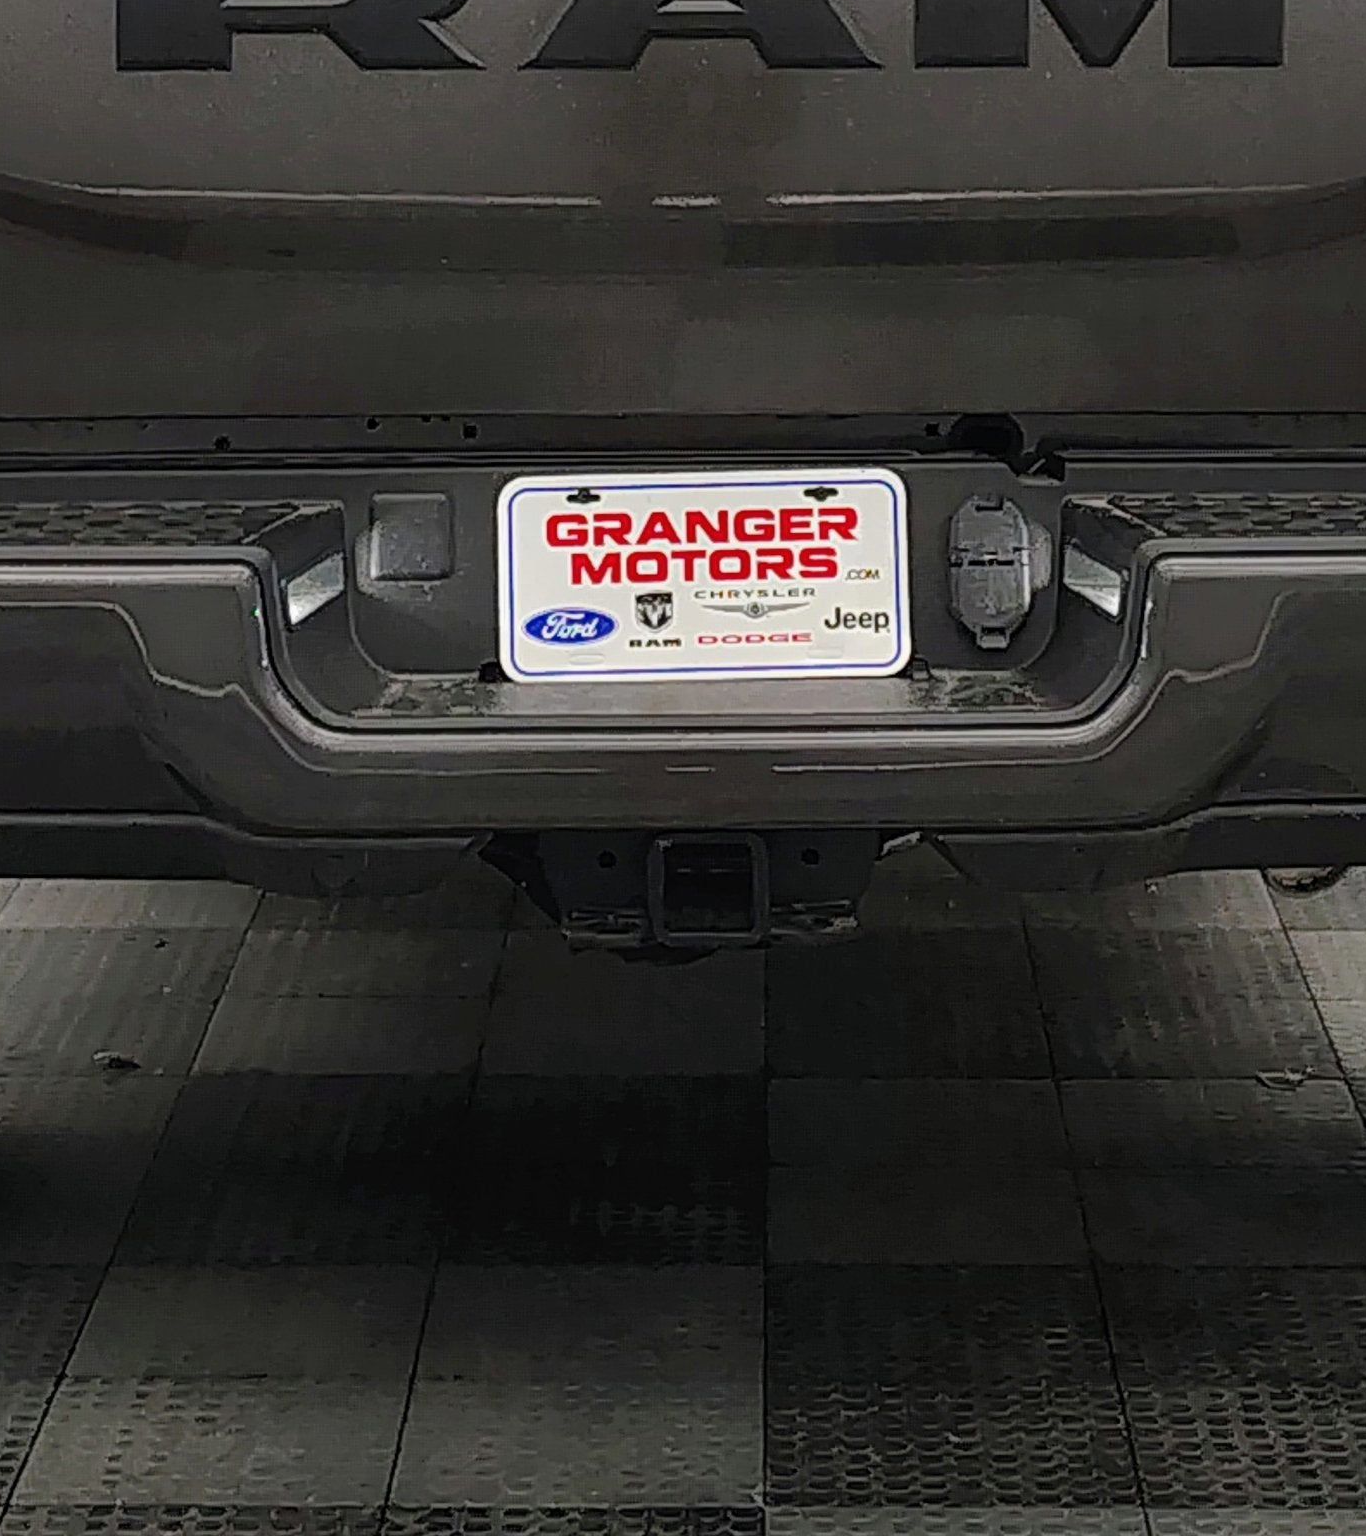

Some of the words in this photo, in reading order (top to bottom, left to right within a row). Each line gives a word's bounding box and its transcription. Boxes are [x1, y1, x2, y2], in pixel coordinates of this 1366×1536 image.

[545, 507, 858, 547] GRANGER
[571, 546, 838, 585] MOTORS
[693, 587, 817, 600] CHRYSLER
[541, 612, 599, 640] Ford
[824, 607, 889, 633] Jeep
[628, 638, 683, 648] RAM
[697, 632, 813, 645] DODGE
